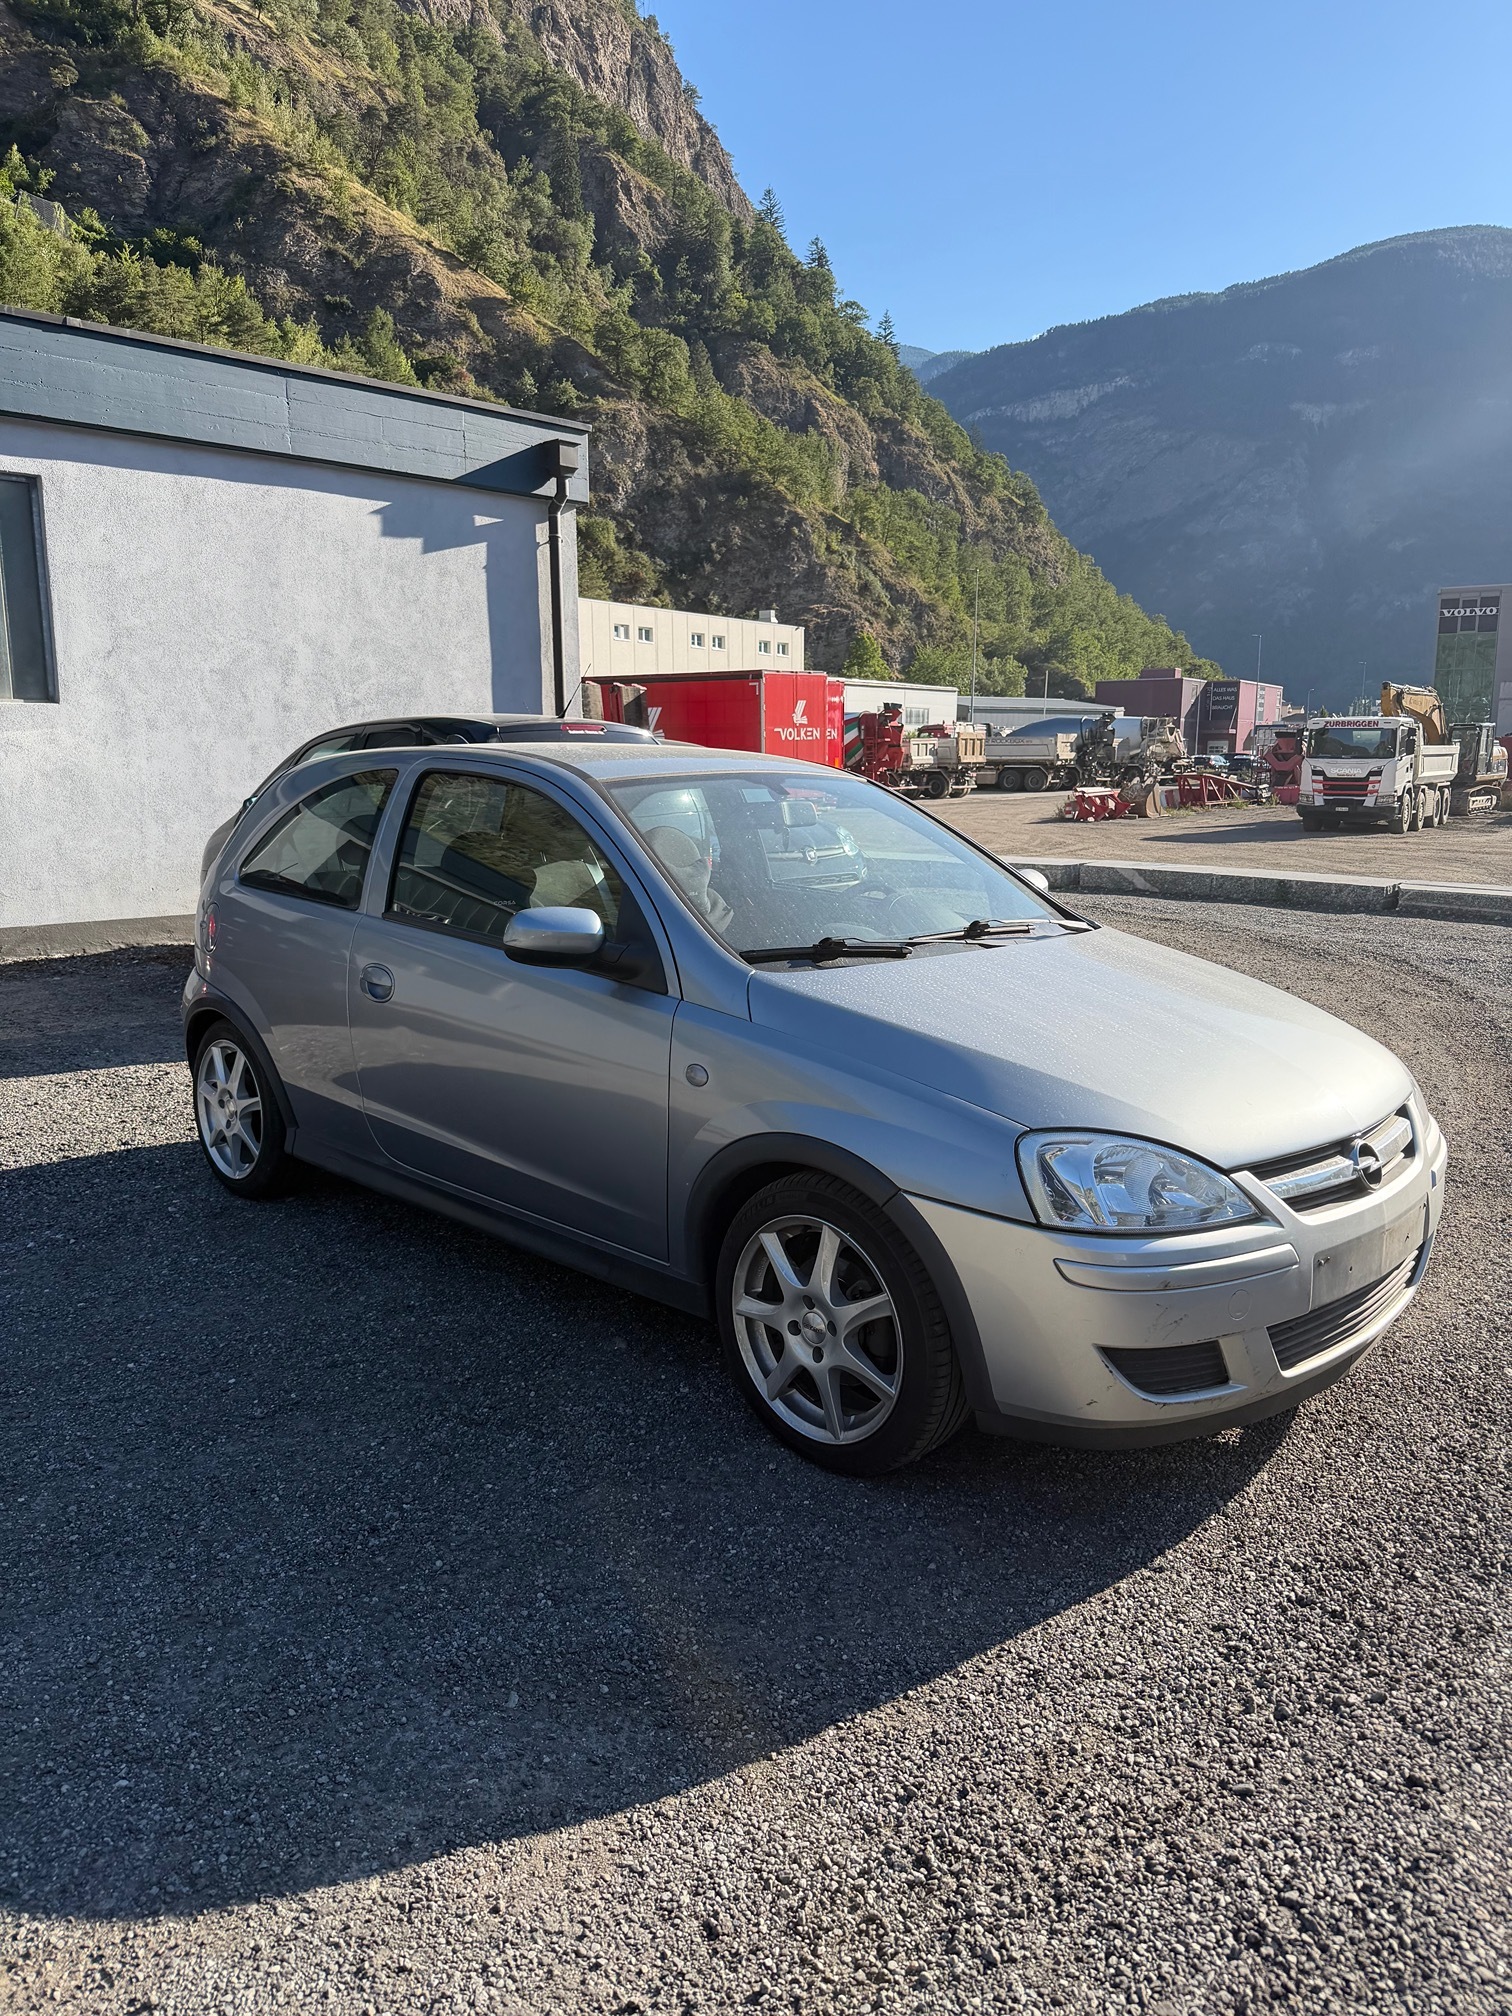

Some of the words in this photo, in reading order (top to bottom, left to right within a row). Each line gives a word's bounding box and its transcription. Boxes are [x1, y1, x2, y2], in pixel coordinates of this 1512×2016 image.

[1441, 606, 1498, 617] VOLVO
[1323, 720, 1380, 728] ZURBRIGGEN
[774, 727, 821, 741] VOLKEN
